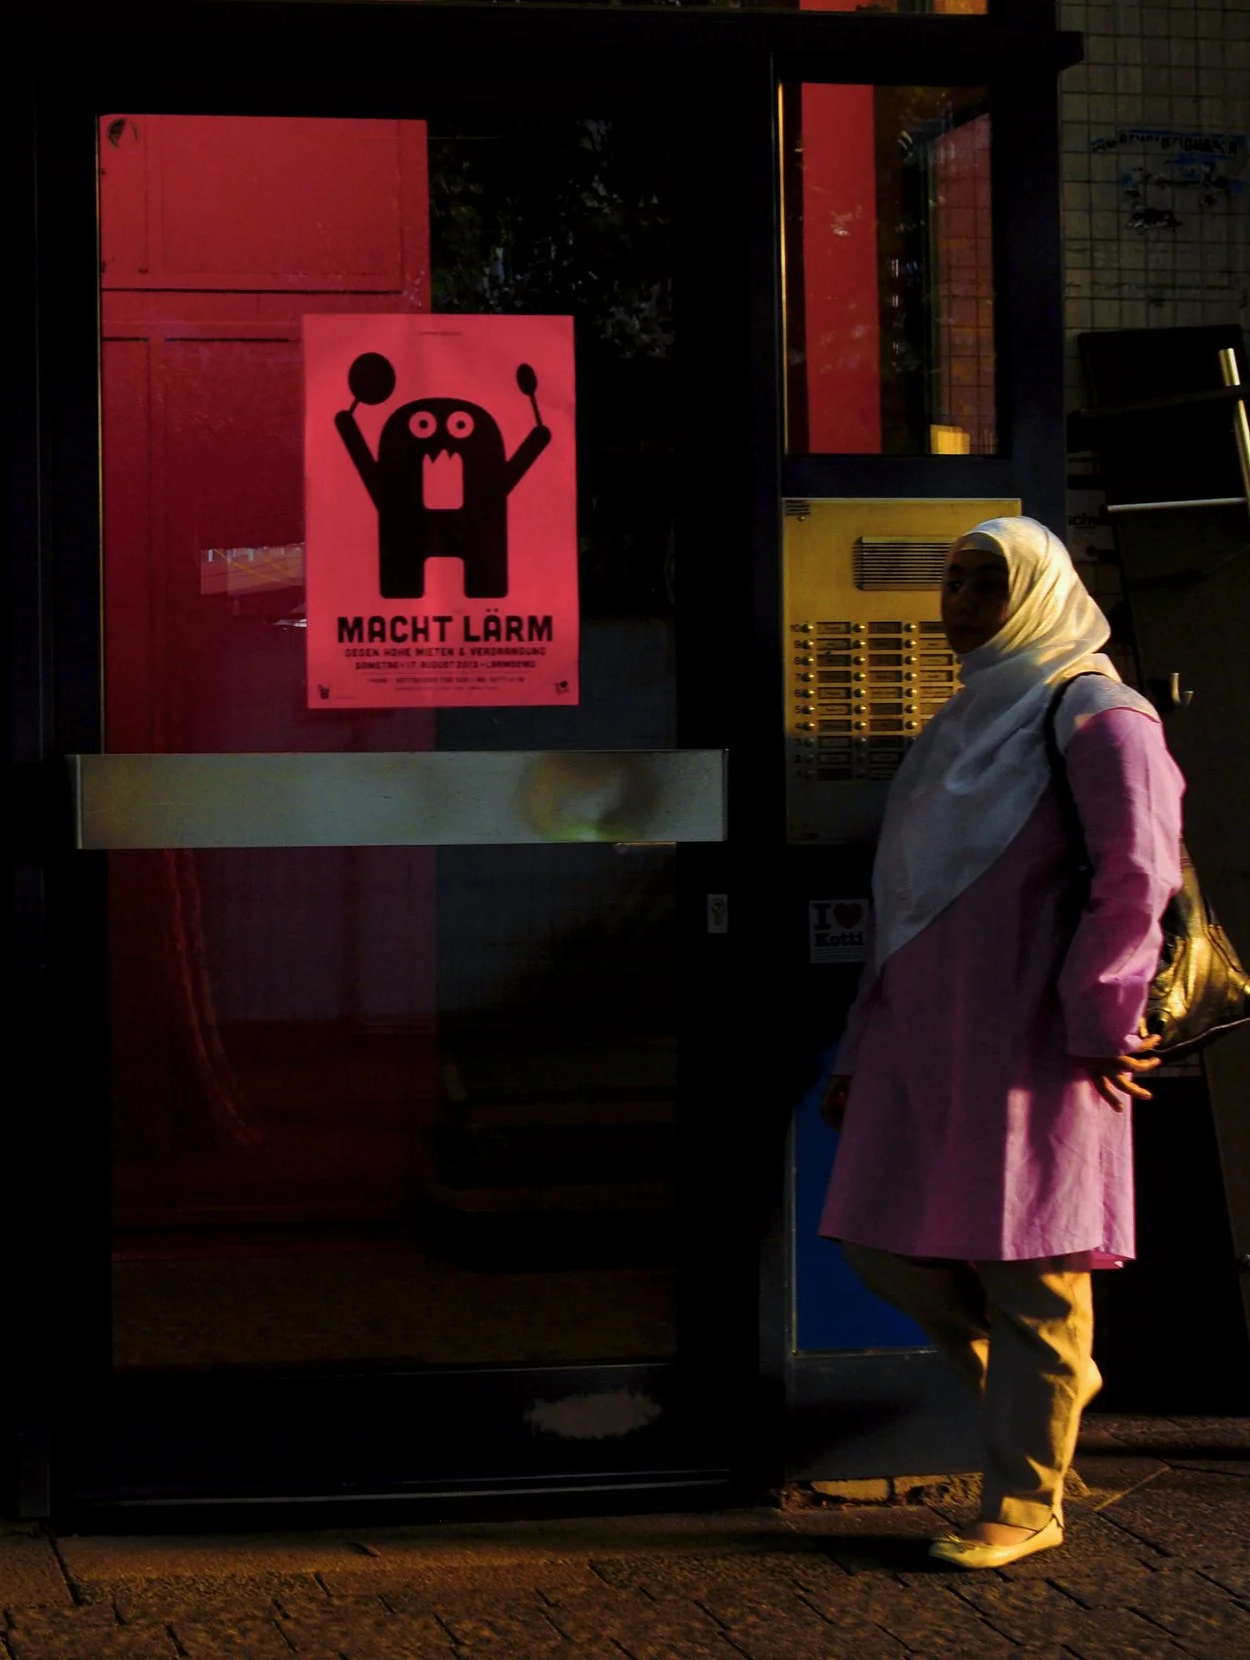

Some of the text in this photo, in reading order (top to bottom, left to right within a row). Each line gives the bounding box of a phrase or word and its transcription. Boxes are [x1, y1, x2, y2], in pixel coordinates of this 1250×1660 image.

[337, 608, 553, 643] MACHT LÄRM
[345, 648, 380, 658] GEGEN
[383, 648, 411, 657] HOHE
[415, 648, 455, 657] MIETEN
[458, 647, 466, 657] &
[812, 902, 831, 930] I
[814, 931, 865, 947] Kotti
